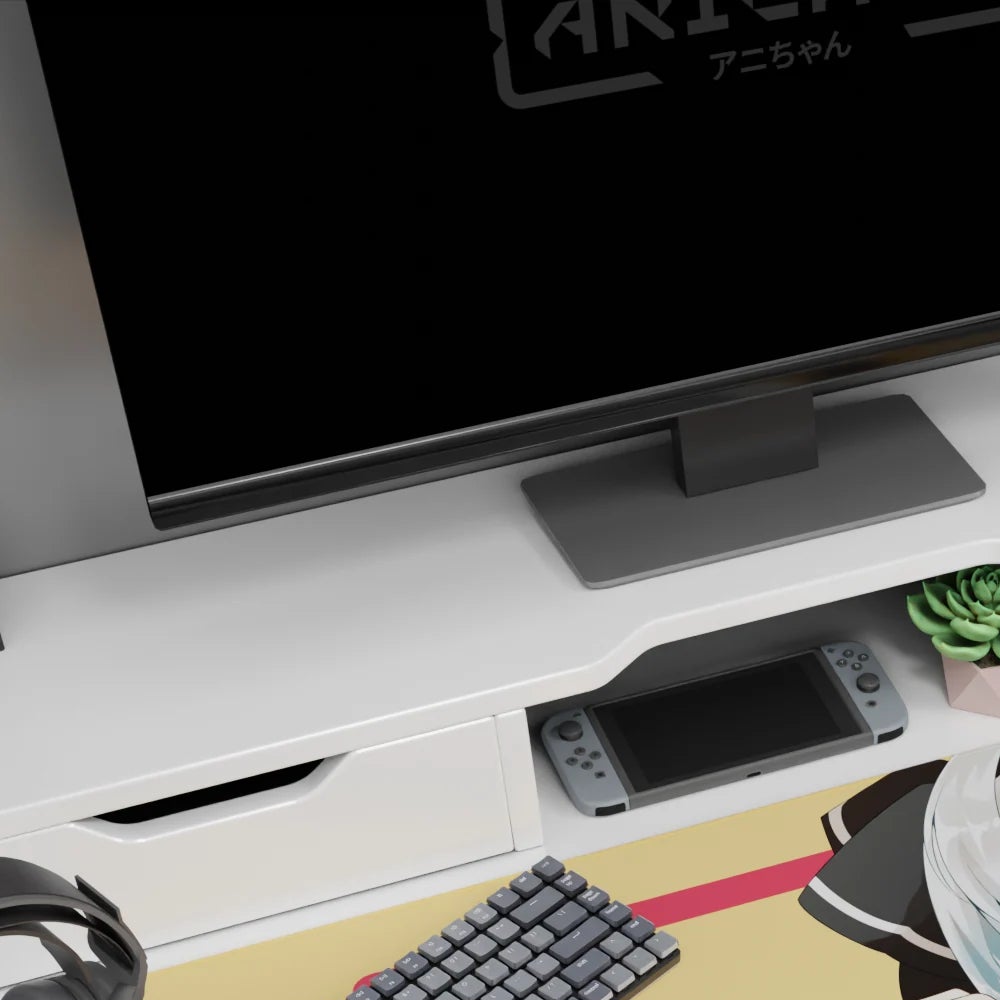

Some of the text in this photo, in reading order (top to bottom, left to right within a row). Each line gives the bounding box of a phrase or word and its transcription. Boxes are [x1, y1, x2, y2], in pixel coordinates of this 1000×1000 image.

[709, 30, 852, 81] アニちゃん
